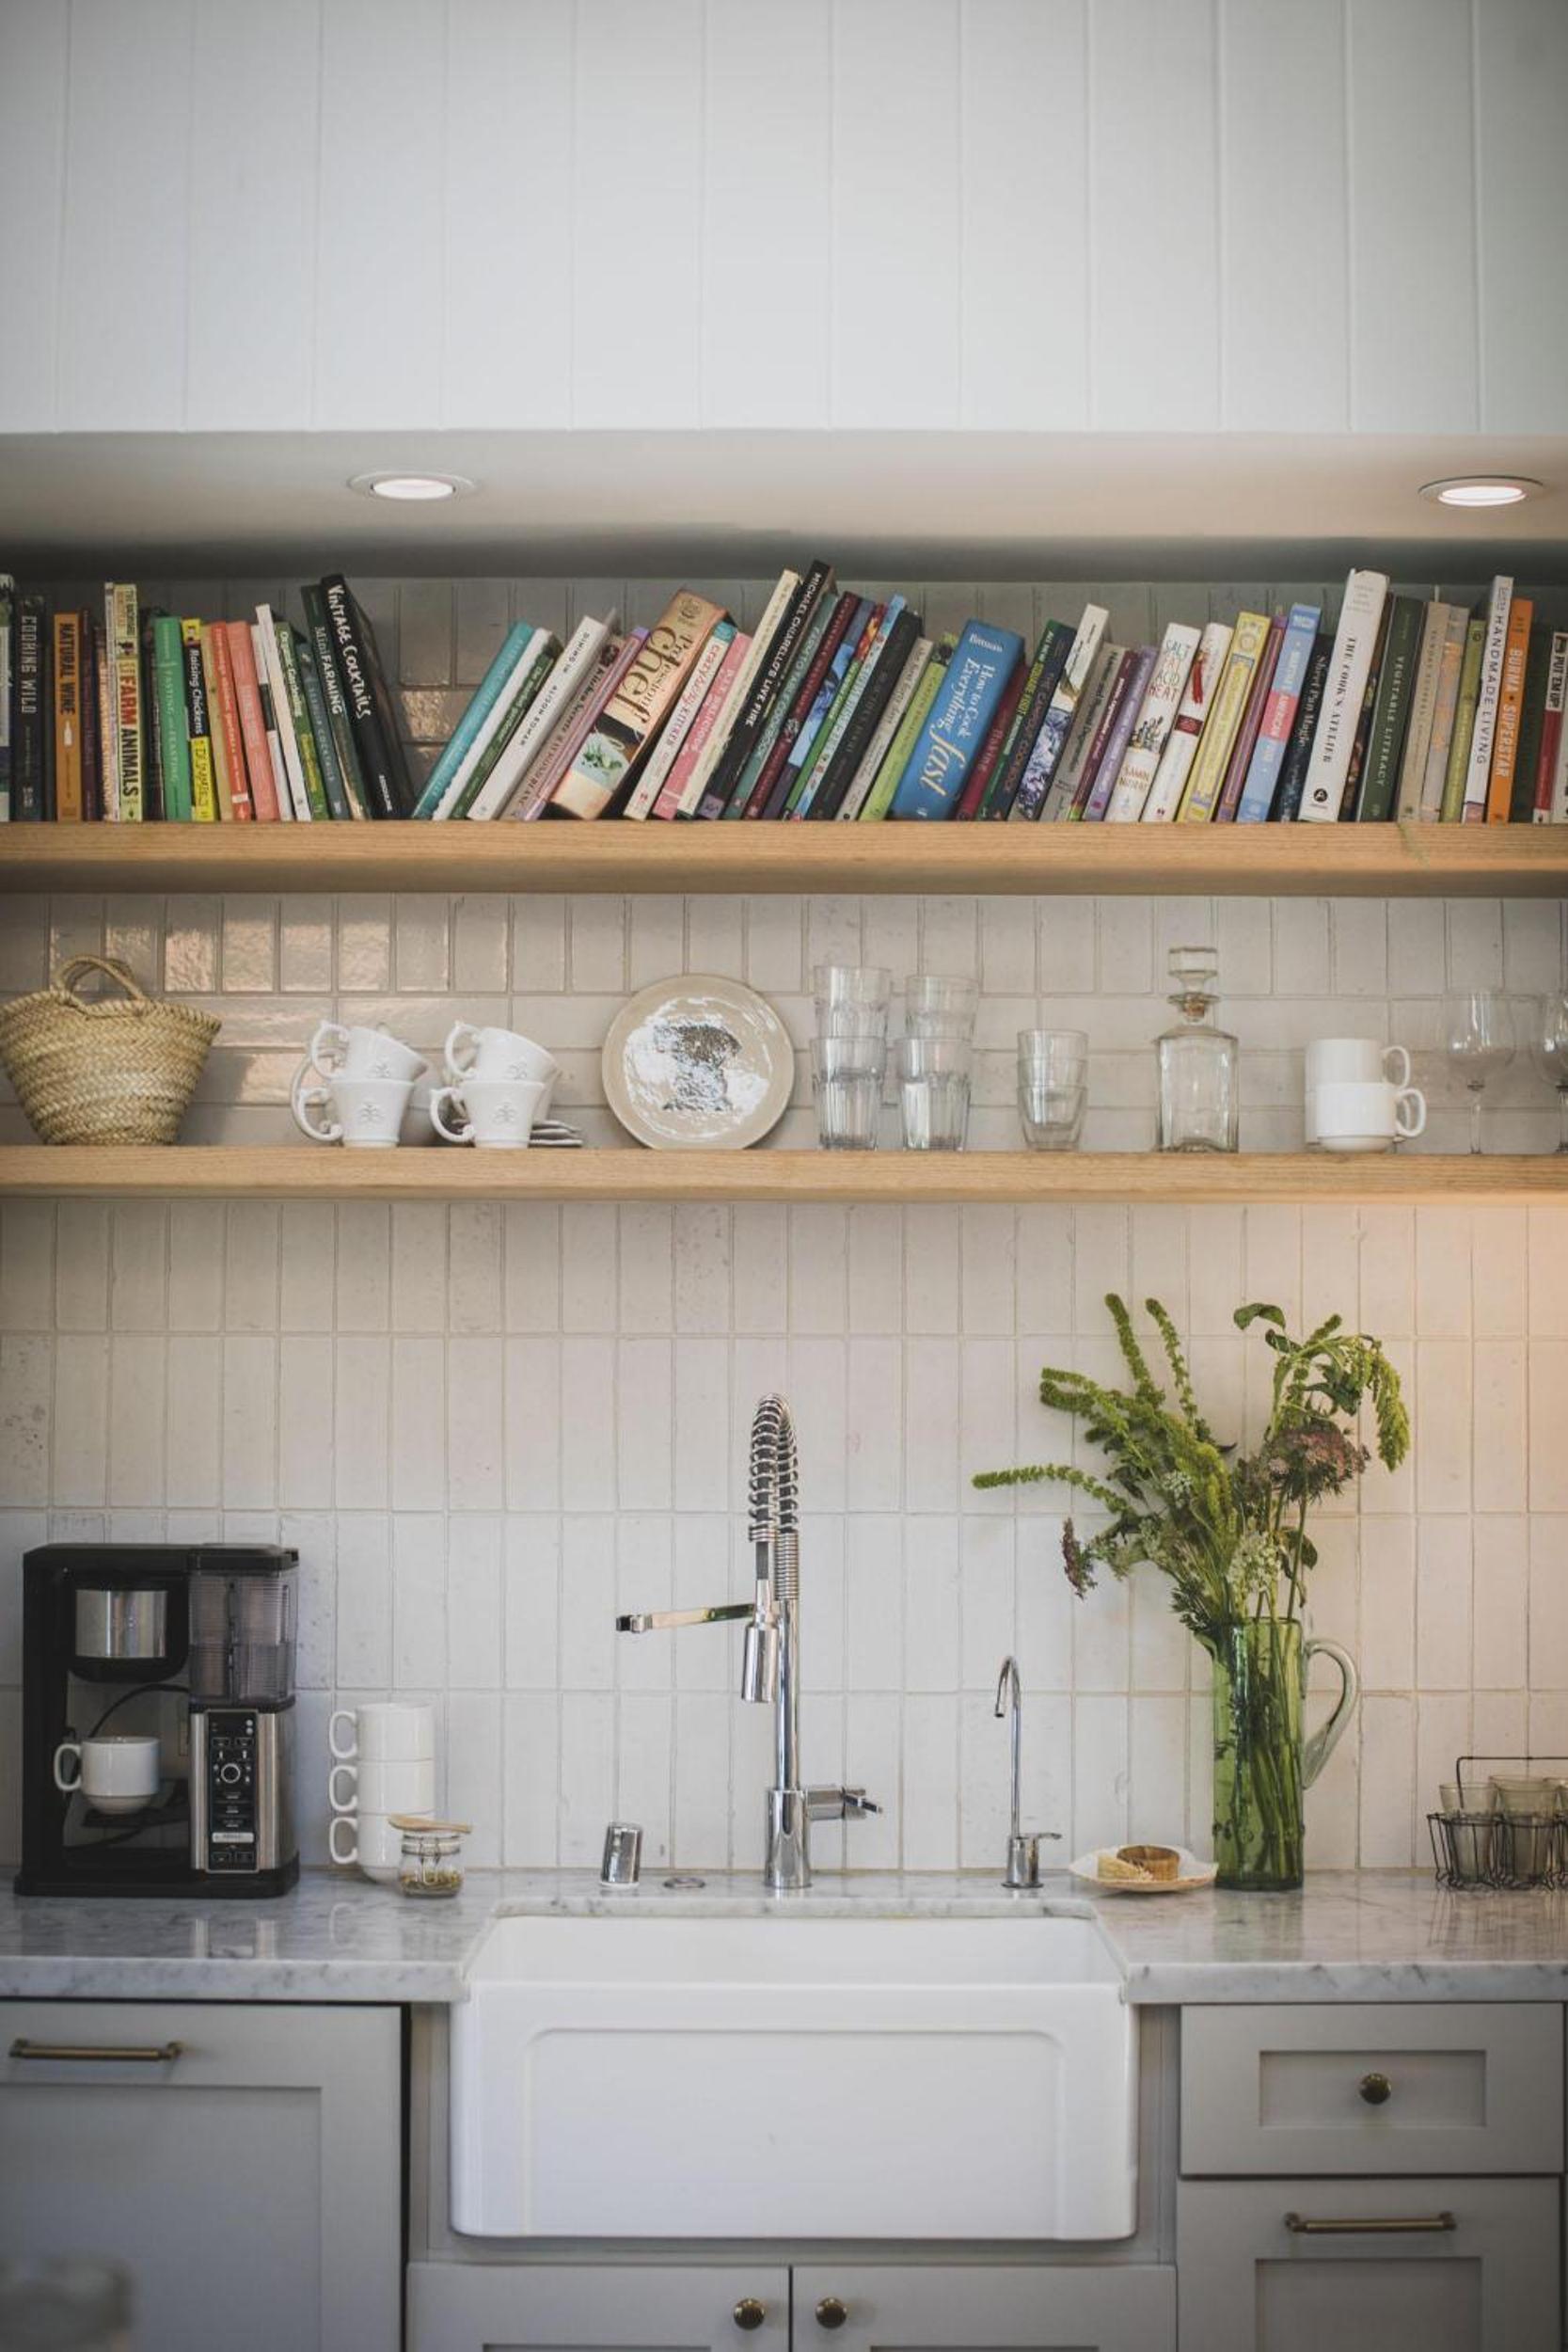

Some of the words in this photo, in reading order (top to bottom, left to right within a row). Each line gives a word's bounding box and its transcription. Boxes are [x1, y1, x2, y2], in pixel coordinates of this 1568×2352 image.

[799, 572, 821, 617] MICHAEL
[21, 614, 37, 673] COOKING
[58, 623, 75, 677] NATURAL
[280, 631, 294, 668] Organic
[768, 616, 801, 678] CHIARELLO'S
[1165, 639, 1190, 659] SALT
[1345, 637, 1356, 660] THE
[1484, 615, 1504, 704] HANDMADE
[1551, 655, 1564, 674] PUT
[186, 647, 201, 688] Raising
[614, 626, 680, 723] chef
[758, 678, 773, 702] LIVE
[977, 664, 995, 693] How
[1311, 657, 1325, 687] Sheet
[1337, 665, 1349, 706] COOK'S
[1387, 658, 1403, 721] VEGETABLE
[1506, 648, 1524, 693] BURMA
[22, 680, 36, 712] WILD
[58, 681, 75, 716] WINE
[119, 676, 137, 725] FARM
[190, 688, 205, 734] Chickens
[745, 703, 762, 727] FIRE
[939, 657, 980, 733] Everything
[970, 694, 981, 707] to
[1148, 684, 1180, 703] HEAT
[1269, 693, 1290, 738] AMERICAN
[1307, 691, 1318, 711] Pan
[958, 707, 977, 738] Cook
[1299, 715, 1313, 746] Magic
[1323, 714, 1340, 762] ATELIER
[1477, 711, 1491, 764] LIVING
[1496, 704, 1516, 777] SUPERSTAR
[120, 727, 139, 797] ANIMALS
[921, 723, 965, 796] fast
[1376, 728, 1392, 787] LITERACY
